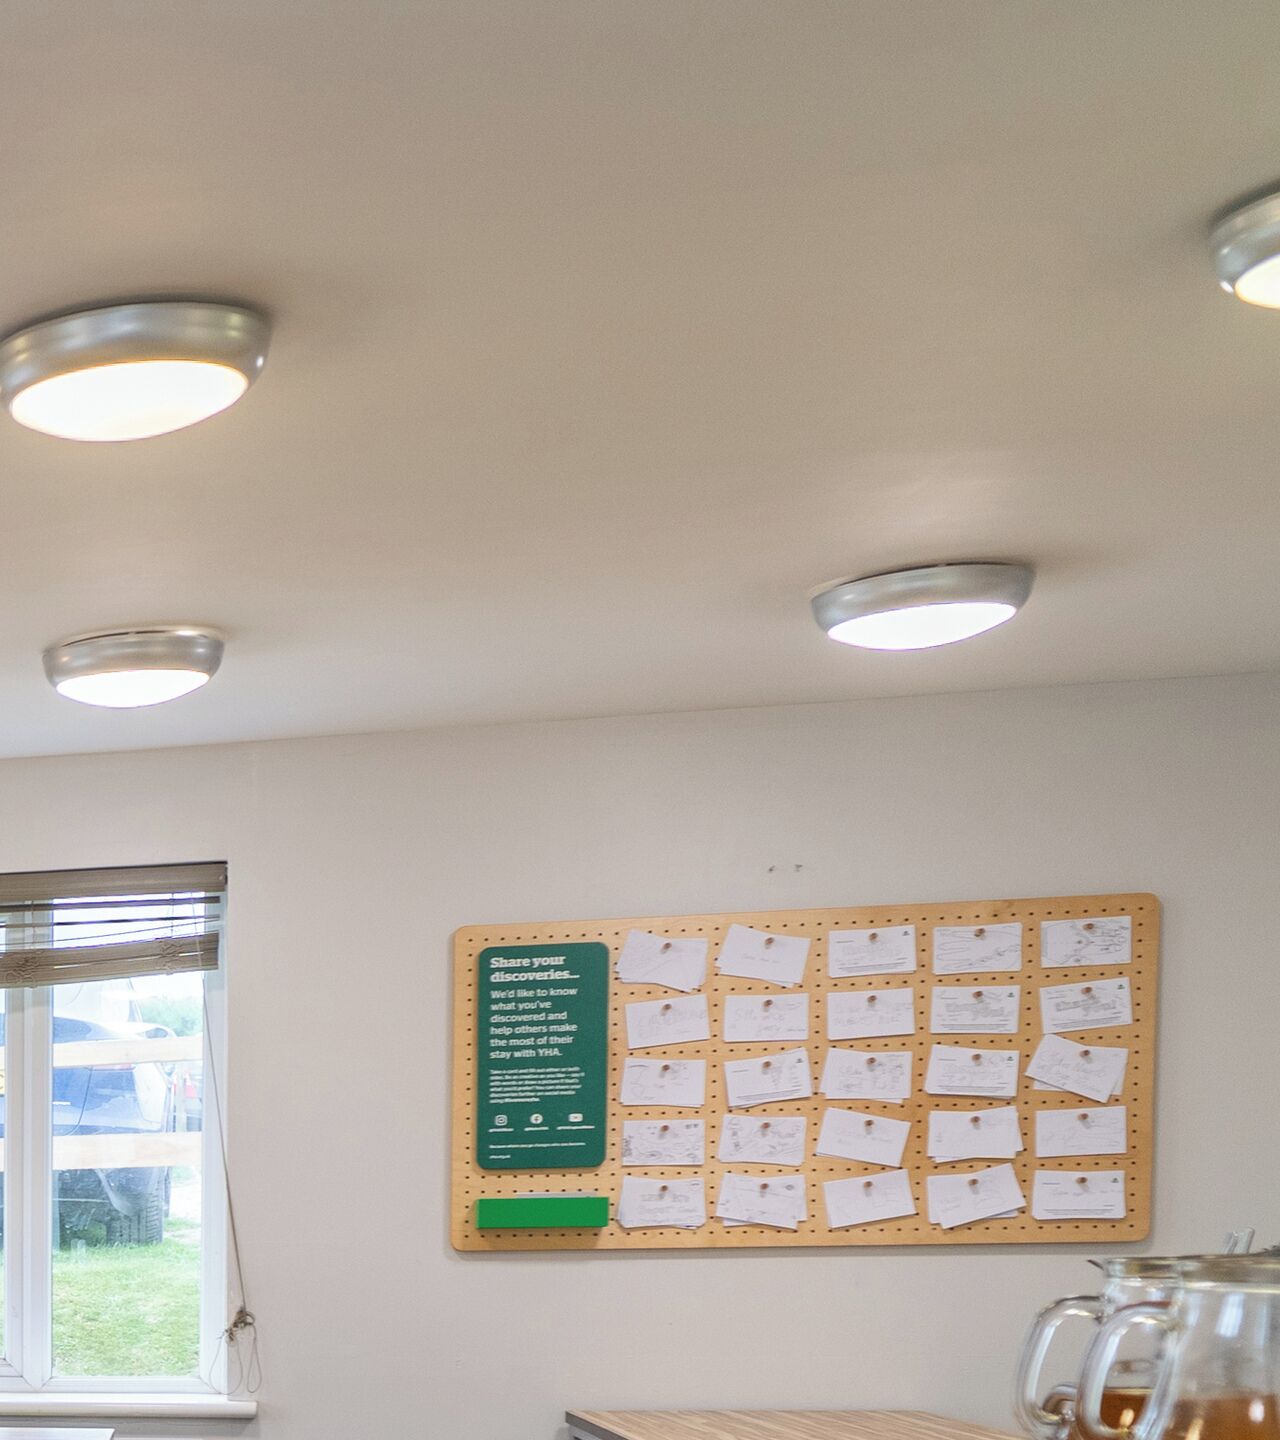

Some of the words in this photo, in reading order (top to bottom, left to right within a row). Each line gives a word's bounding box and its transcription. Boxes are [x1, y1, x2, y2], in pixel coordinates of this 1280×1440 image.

[490, 956, 531, 969] Share
[532, 956, 566, 968] your
[490, 990, 515, 999] We'd
[517, 989, 535, 998] like
[536, 989, 548, 997] to
[549, 988, 578, 996] know
[490, 1002, 516, 1010] what
[518, 1000, 552, 1011] you've
[490, 1012, 546, 1022] discovered
[547, 1011, 567, 1020] and
[490, 1026, 512, 1036] help
[514, 1025, 547, 1034] others
[549, 1023, 578, 1032] make
[490, 1038, 507, 1047] the
[509, 1037, 535, 1046] most
[536, 1036, 548, 1044] of
[549, 1035, 574, 1044] their
[489, 1050, 512, 1060] stay
[513, 1049, 536, 1058] with
[537, 1047, 563, 1057] YHA.
